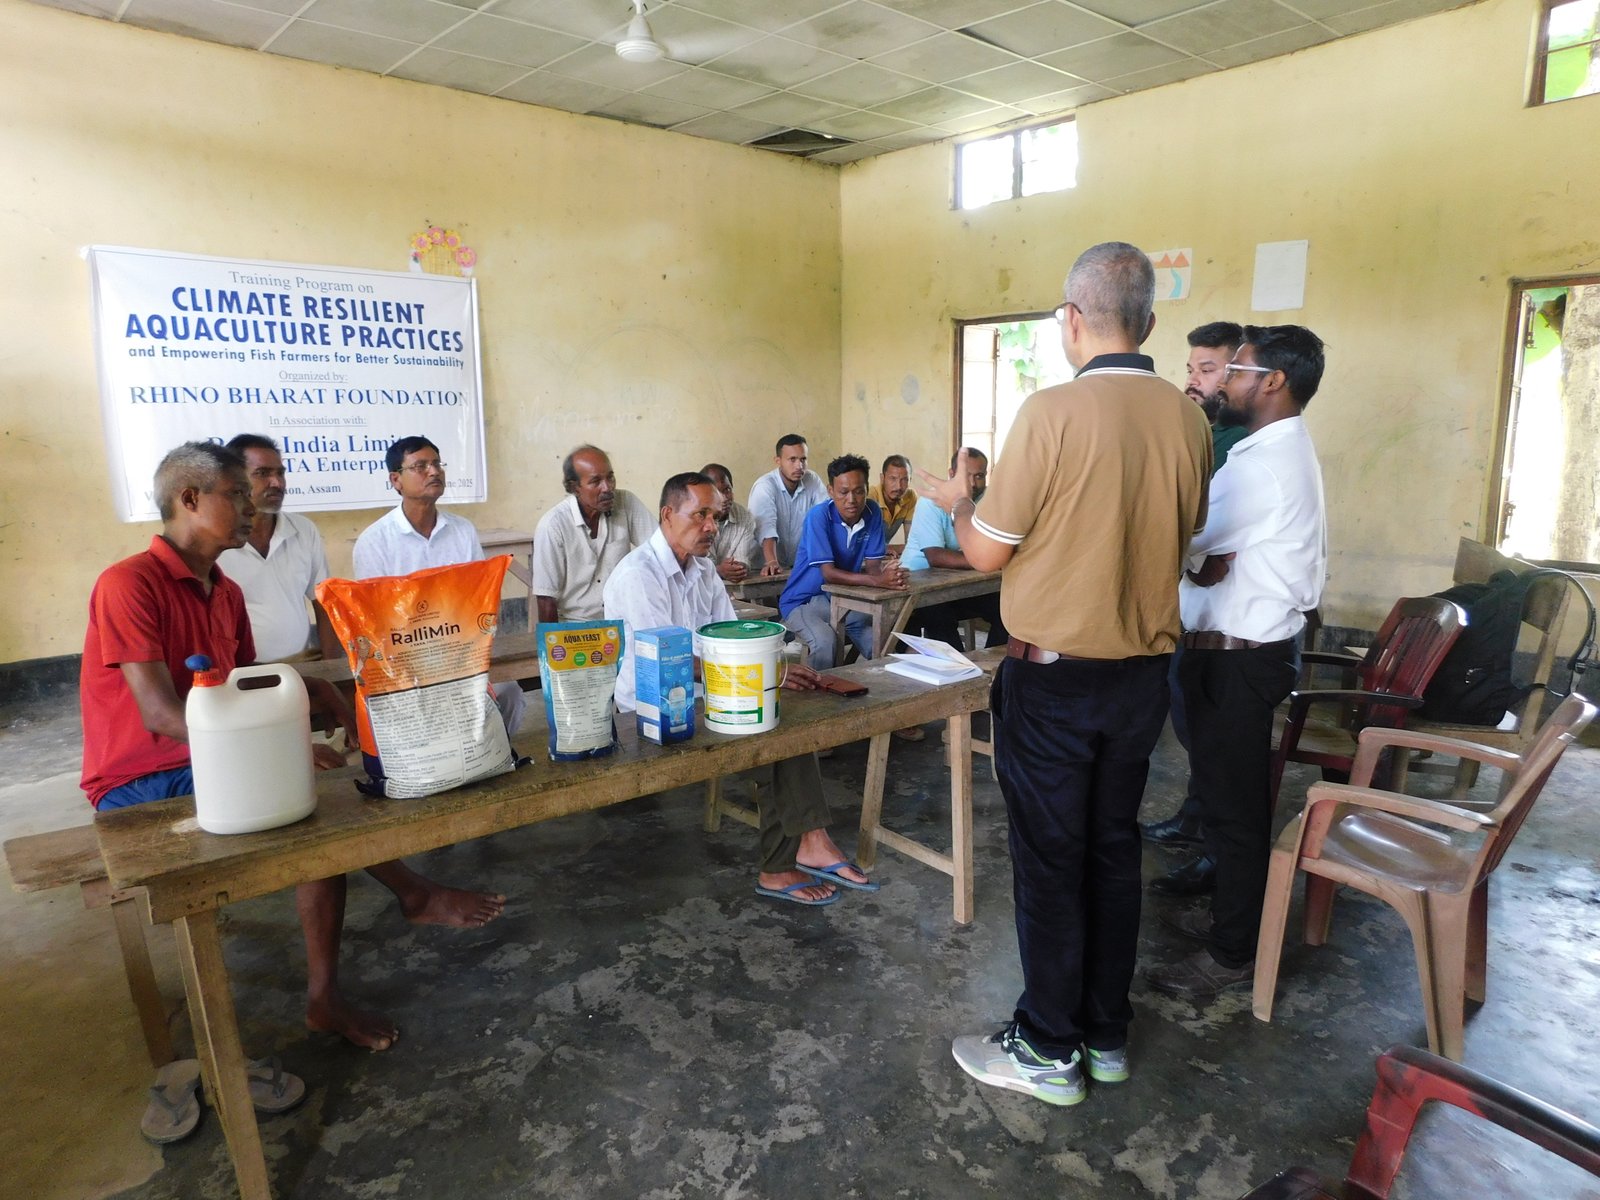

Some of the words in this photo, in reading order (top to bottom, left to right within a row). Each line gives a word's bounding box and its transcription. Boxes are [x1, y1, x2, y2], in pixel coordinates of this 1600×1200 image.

[229, 271, 292, 290] Training
[296, 277, 354, 294] Program
[358, 284, 374, 294] on
[172, 286, 292, 317] CLIMATE
[303, 296, 425, 325] RESILIENT
[125, 314, 331, 346] AQUACULTURE
[341, 325, 464, 352] PRACTICES
[129, 345, 155, 357] and
[162, 346, 246, 362] Empowering
[251, 349, 276, 360] Fish
[281, 350, 330, 363] Farmers
[334, 352, 351, 363] for
[355, 353, 389, 365] Better
[394, 355, 464, 370] Sustainability
[279, 370, 330, 382] Organized
[333, 372, 349, 383] by:
[129, 386, 219, 404] RHINO
[227, 387, 327, 405] BHARAT
[335, 389, 468, 406] FOUNDATION
[269, 415, 280, 425] In
[282, 415, 340, 426] Association
[343, 416, 367, 426] with:
[283, 435, 340, 453] India
[348, 434, 425, 452] Limi
[317, 457, 387, 474] Enterpr
[308, 485, 341, 495] Assam
[391, 622, 461, 646] RalliMin
[563, 634, 582, 644] AQUA
[582, 633, 601, 642] YEAST
